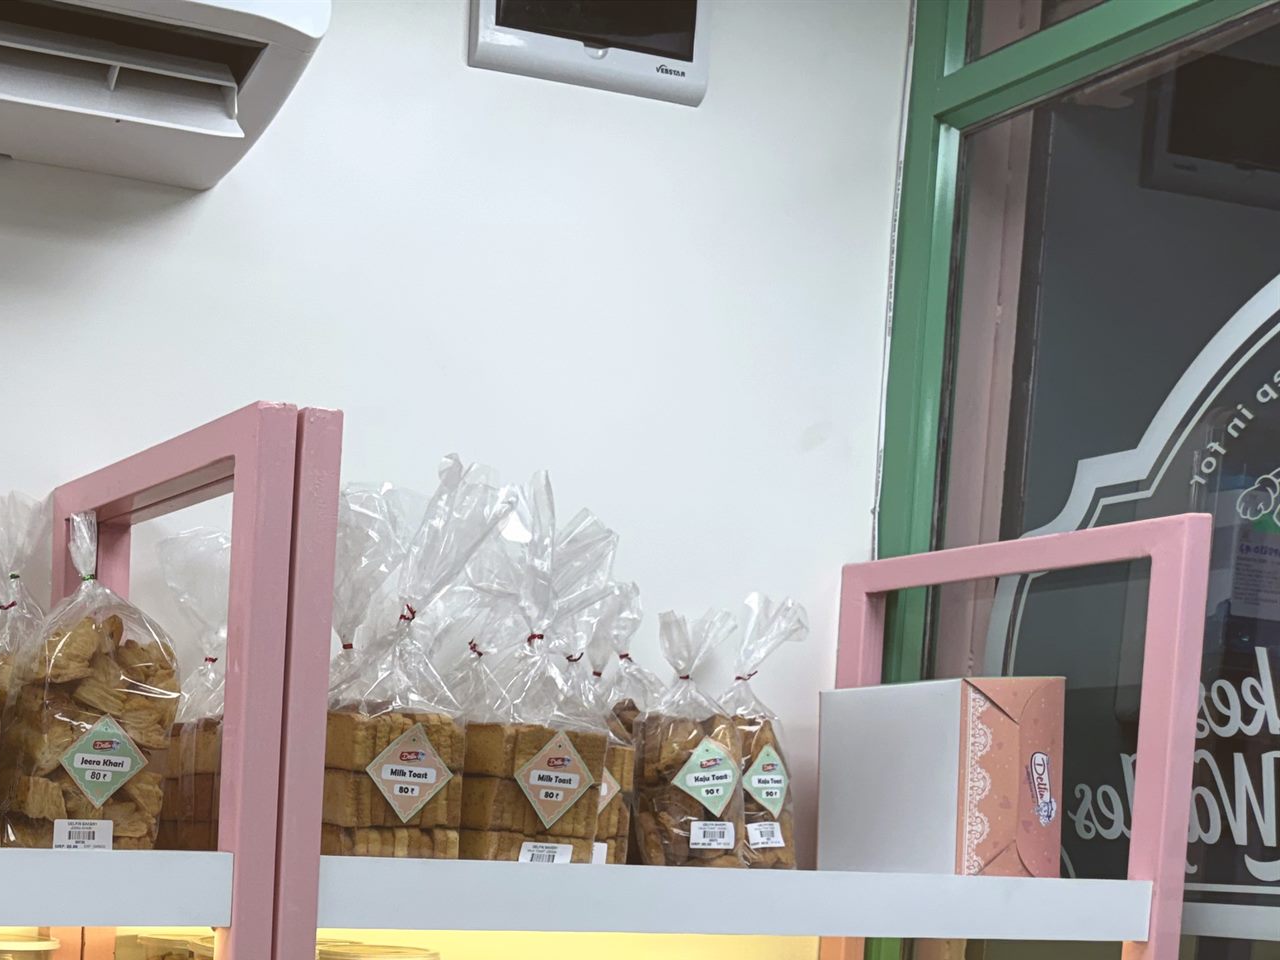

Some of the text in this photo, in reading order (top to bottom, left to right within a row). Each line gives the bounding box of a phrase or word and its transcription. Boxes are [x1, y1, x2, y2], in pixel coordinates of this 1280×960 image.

[80, 757, 124, 768] Jeera Khari
[90, 772, 100, 780] 80
[390, 768, 428, 779] Milk Toast
[1034, 755, 1048, 799] Delfin
[537, 774, 572, 785] Milk Toast
